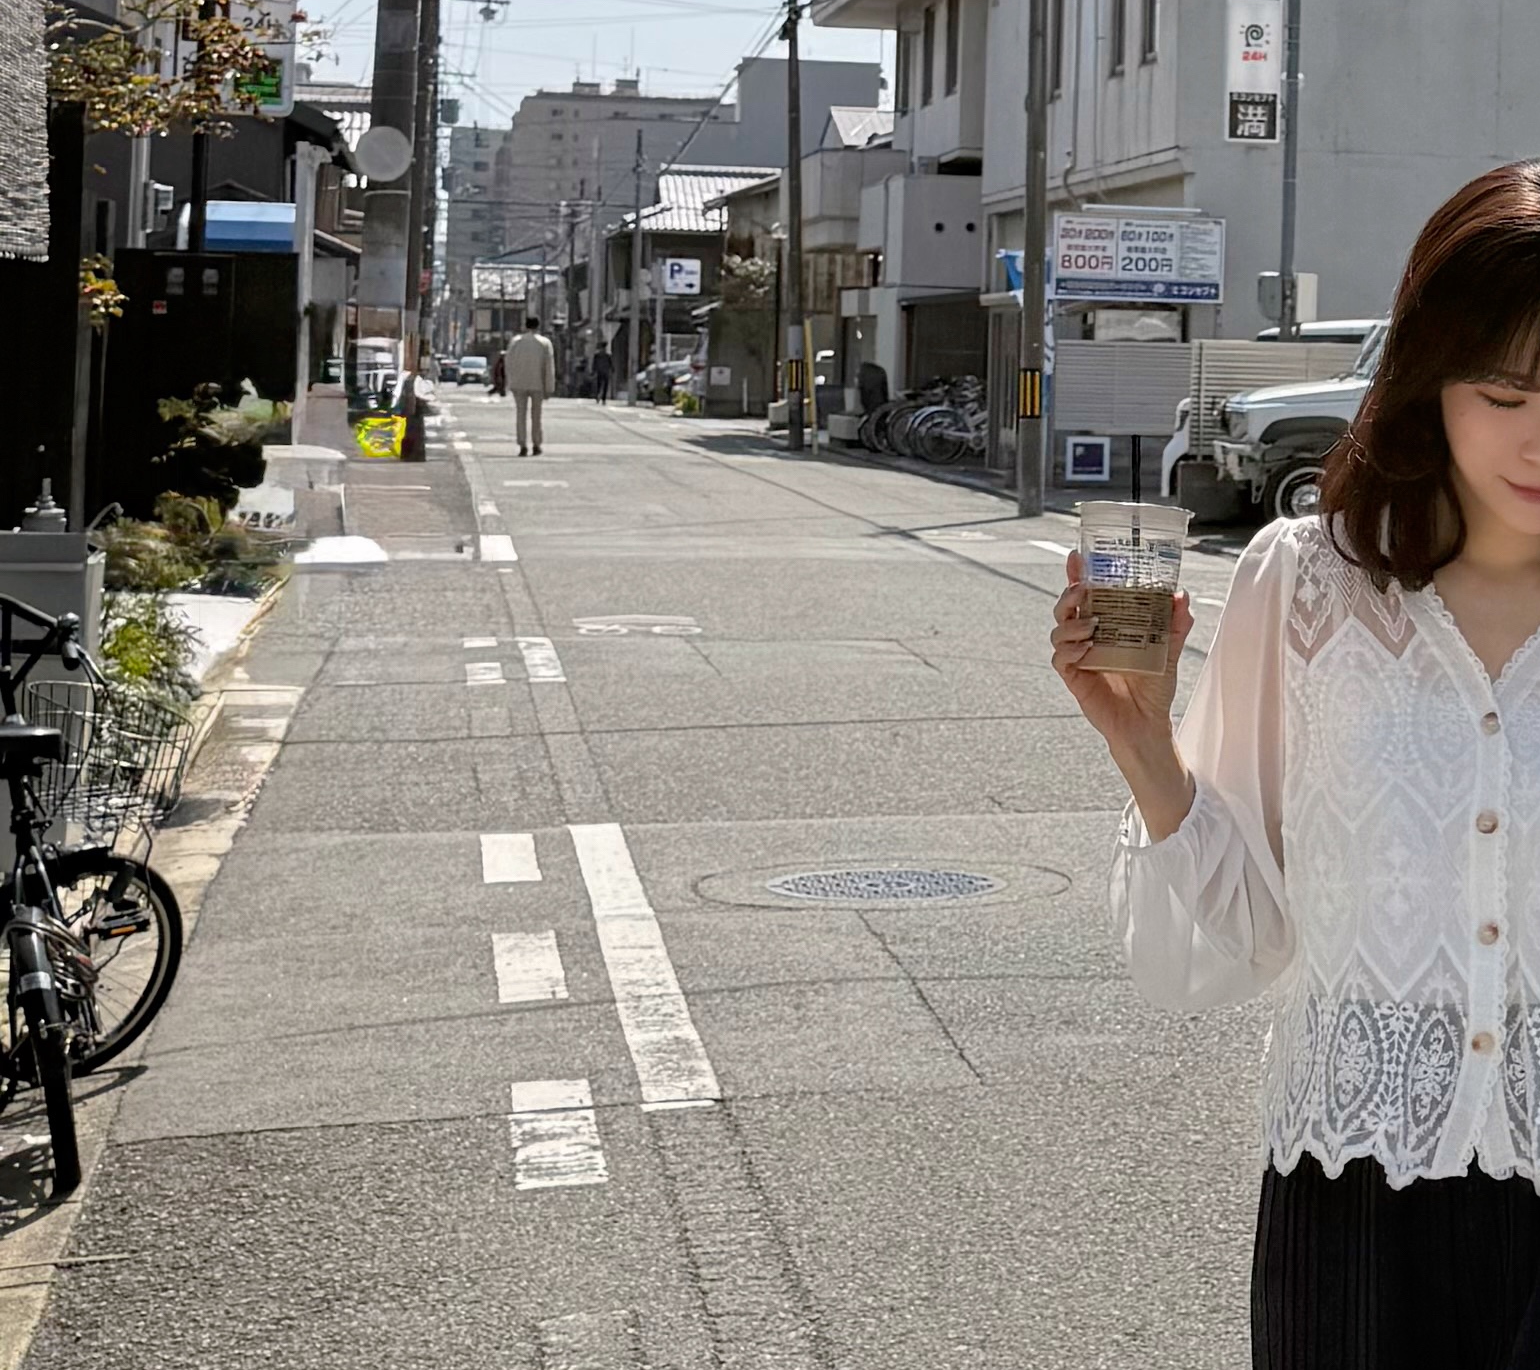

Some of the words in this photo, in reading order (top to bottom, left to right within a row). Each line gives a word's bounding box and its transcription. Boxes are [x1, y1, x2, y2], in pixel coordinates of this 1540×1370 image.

[1242, 51, 1267, 62] 24H
[1236, 104, 1268, 137] 満
[670, 262, 684, 279] P
[1061, 254, 1113, 271] 800円
[1121, 256, 1173, 273] 200円
